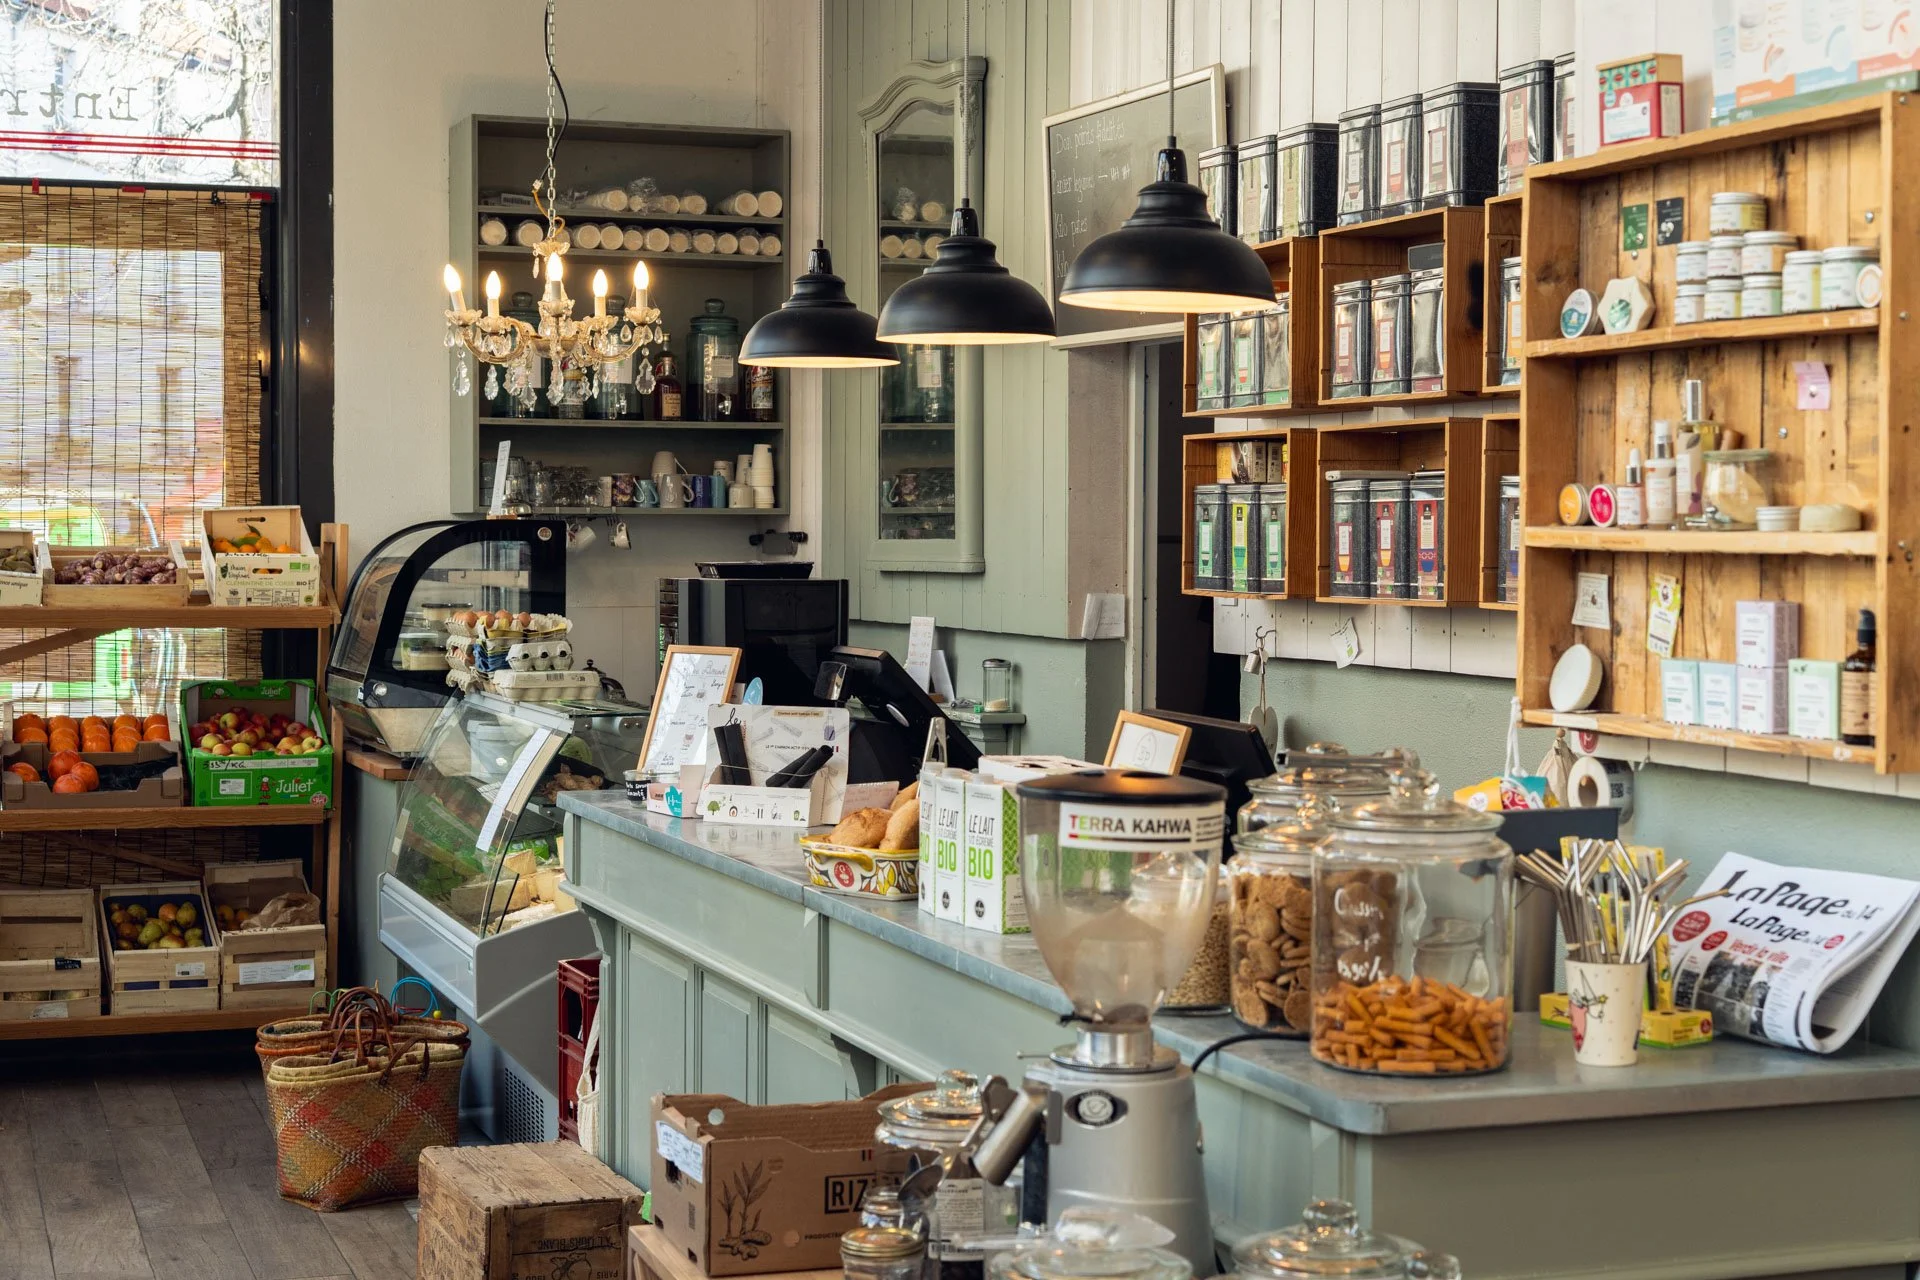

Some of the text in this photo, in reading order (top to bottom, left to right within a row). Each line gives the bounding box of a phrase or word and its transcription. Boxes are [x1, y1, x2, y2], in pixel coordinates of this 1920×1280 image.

[276, 779, 314, 793] Juliet
[938, 808, 947, 826] LE
[946, 809, 959, 829] LAIT
[968, 814, 995, 836] LE LAIT
[1069, 814, 1125, 833] TERRA
[1132, 818, 1192, 834] KAHWA
[937, 839, 957, 872] BIO
[968, 846, 994, 880] BIO
[596, 1270, 618, 1279] PARIS
